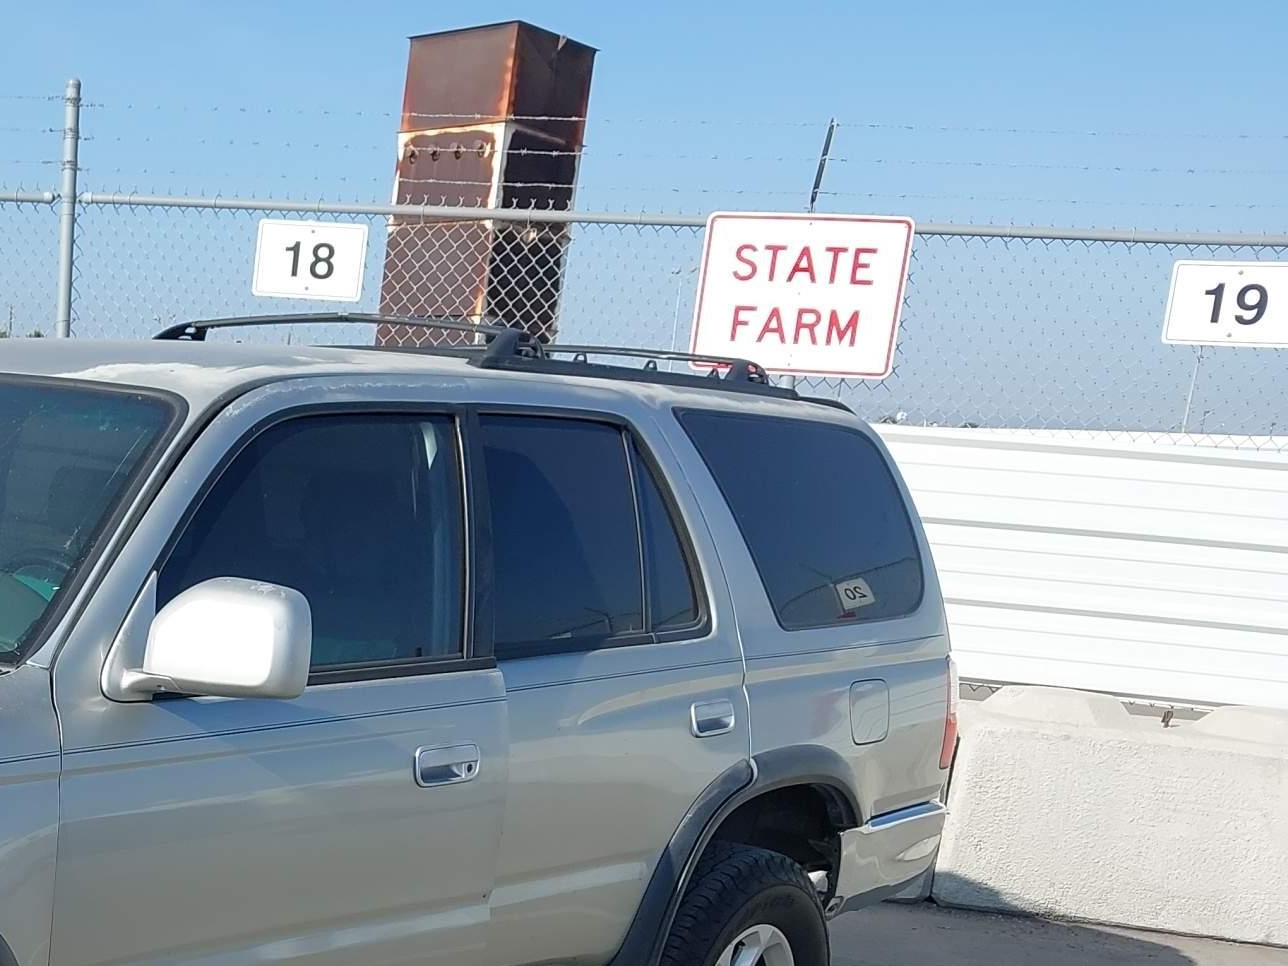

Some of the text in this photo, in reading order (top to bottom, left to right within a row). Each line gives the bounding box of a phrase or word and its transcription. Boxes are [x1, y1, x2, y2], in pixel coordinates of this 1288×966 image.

[285, 241, 335, 280] 18
[732, 244, 878, 286] STATE
[1204, 282, 1269, 326] 19
[729, 305, 860, 347] FARM
